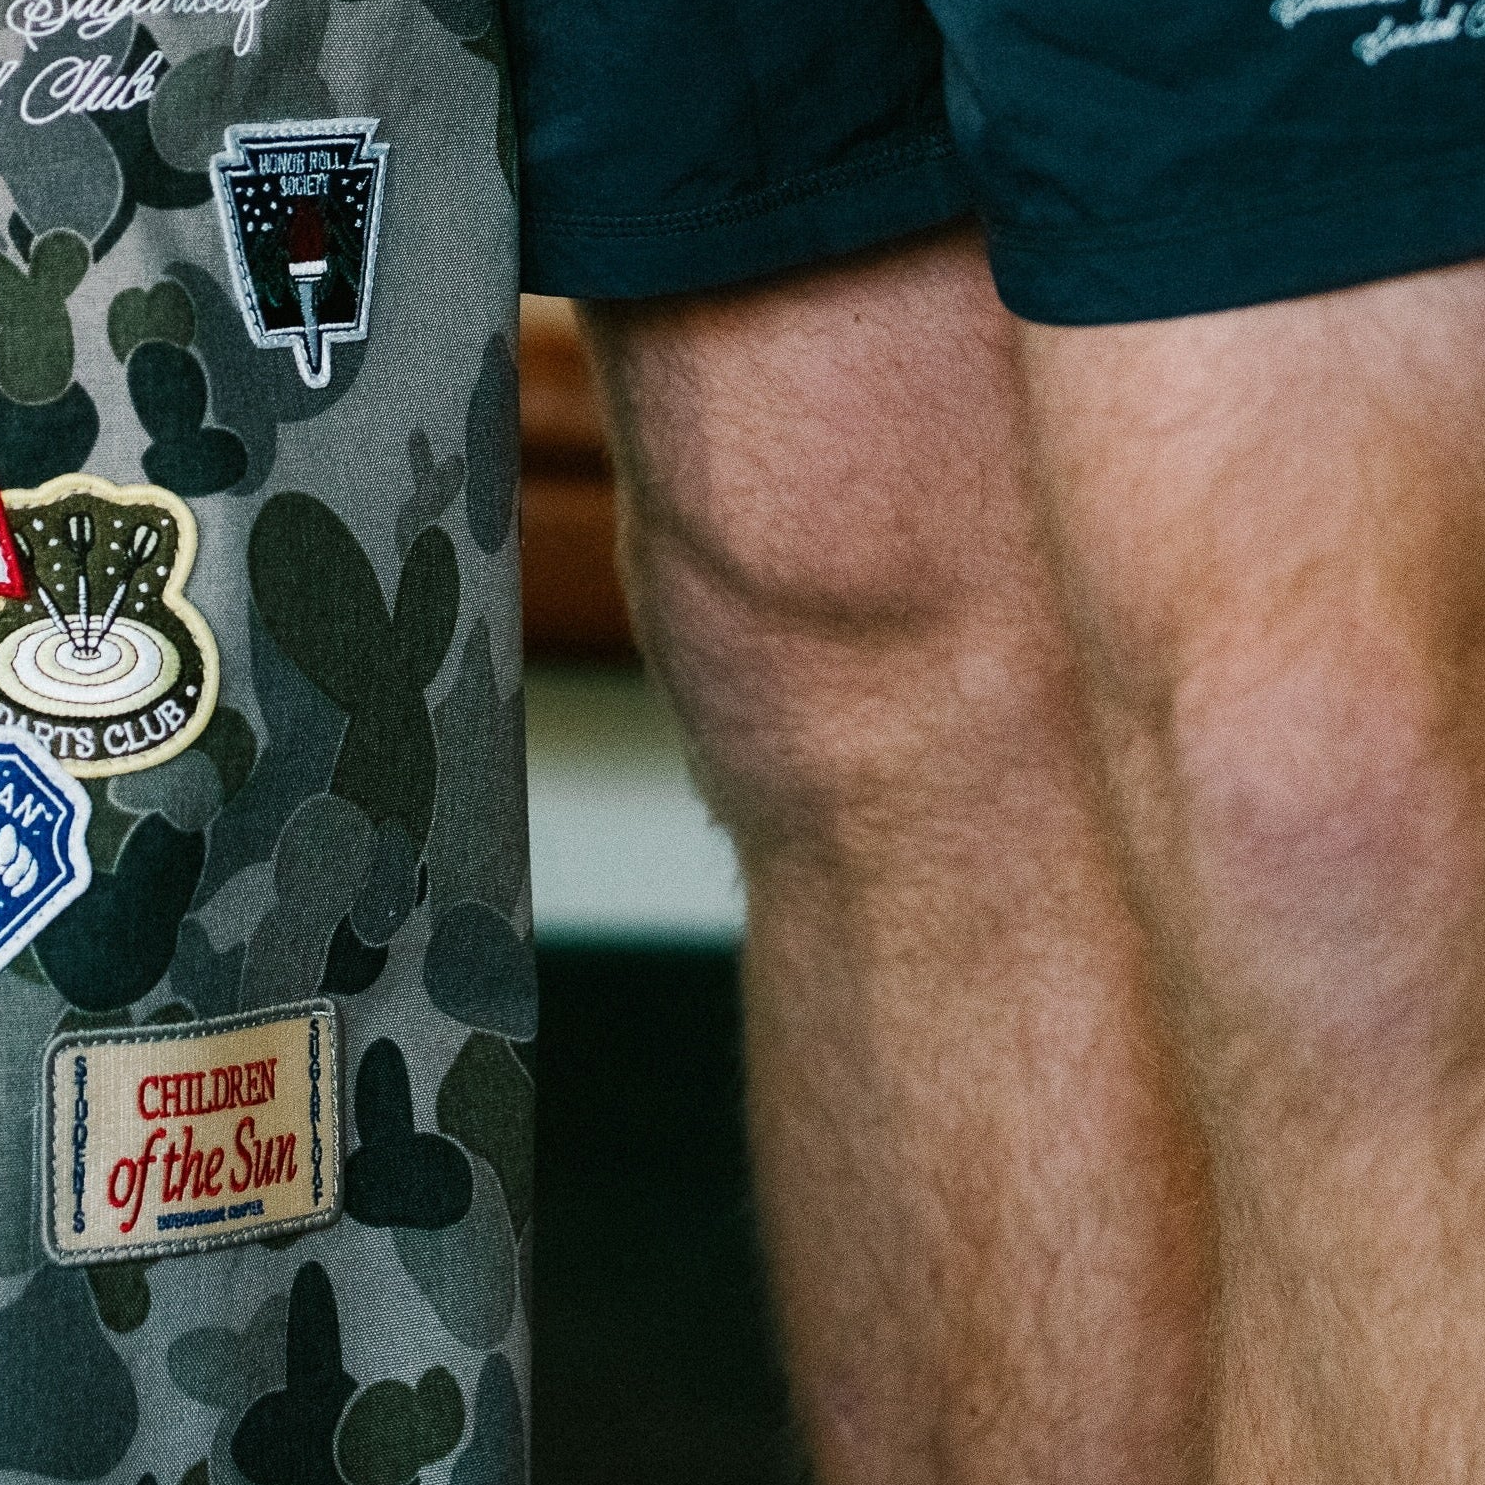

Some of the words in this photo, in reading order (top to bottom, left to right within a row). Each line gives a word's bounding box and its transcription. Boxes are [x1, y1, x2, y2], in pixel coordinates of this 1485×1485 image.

[22, 51, 164, 124] Club
[279, 172, 329, 196] SOCIETY
[103, 699, 186, 755] CLUB
[137, 1057, 278, 1121] CHILDREN
[107, 1127, 167, 1233] of
[162, 1125, 225, 1203] the
[229, 1116, 298, 1193] Sun
